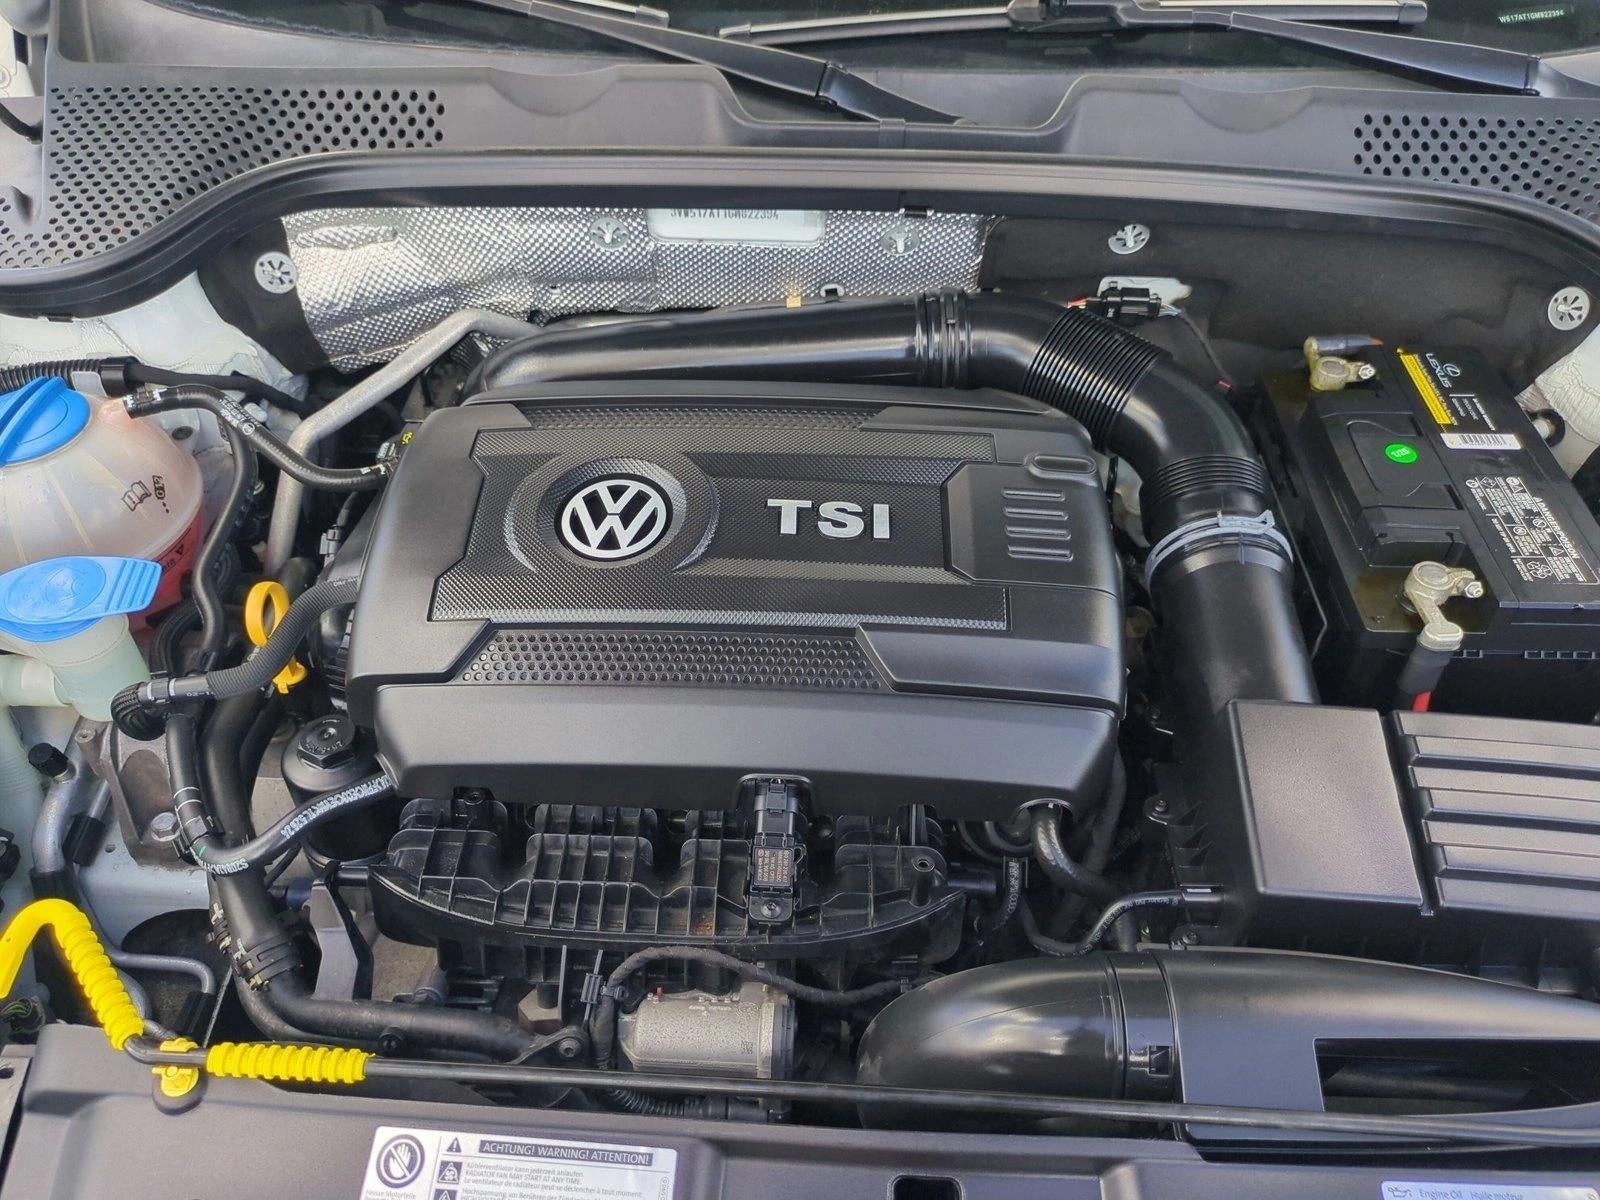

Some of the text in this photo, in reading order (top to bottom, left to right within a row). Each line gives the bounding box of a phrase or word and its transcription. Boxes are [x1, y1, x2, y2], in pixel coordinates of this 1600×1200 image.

[1425, 352, 1452, 388] LEXUS
[767, 498, 891, 540] TSI
[483, 1142, 649, 1165] ACHTUNG! WARNING! ATTENTION!
